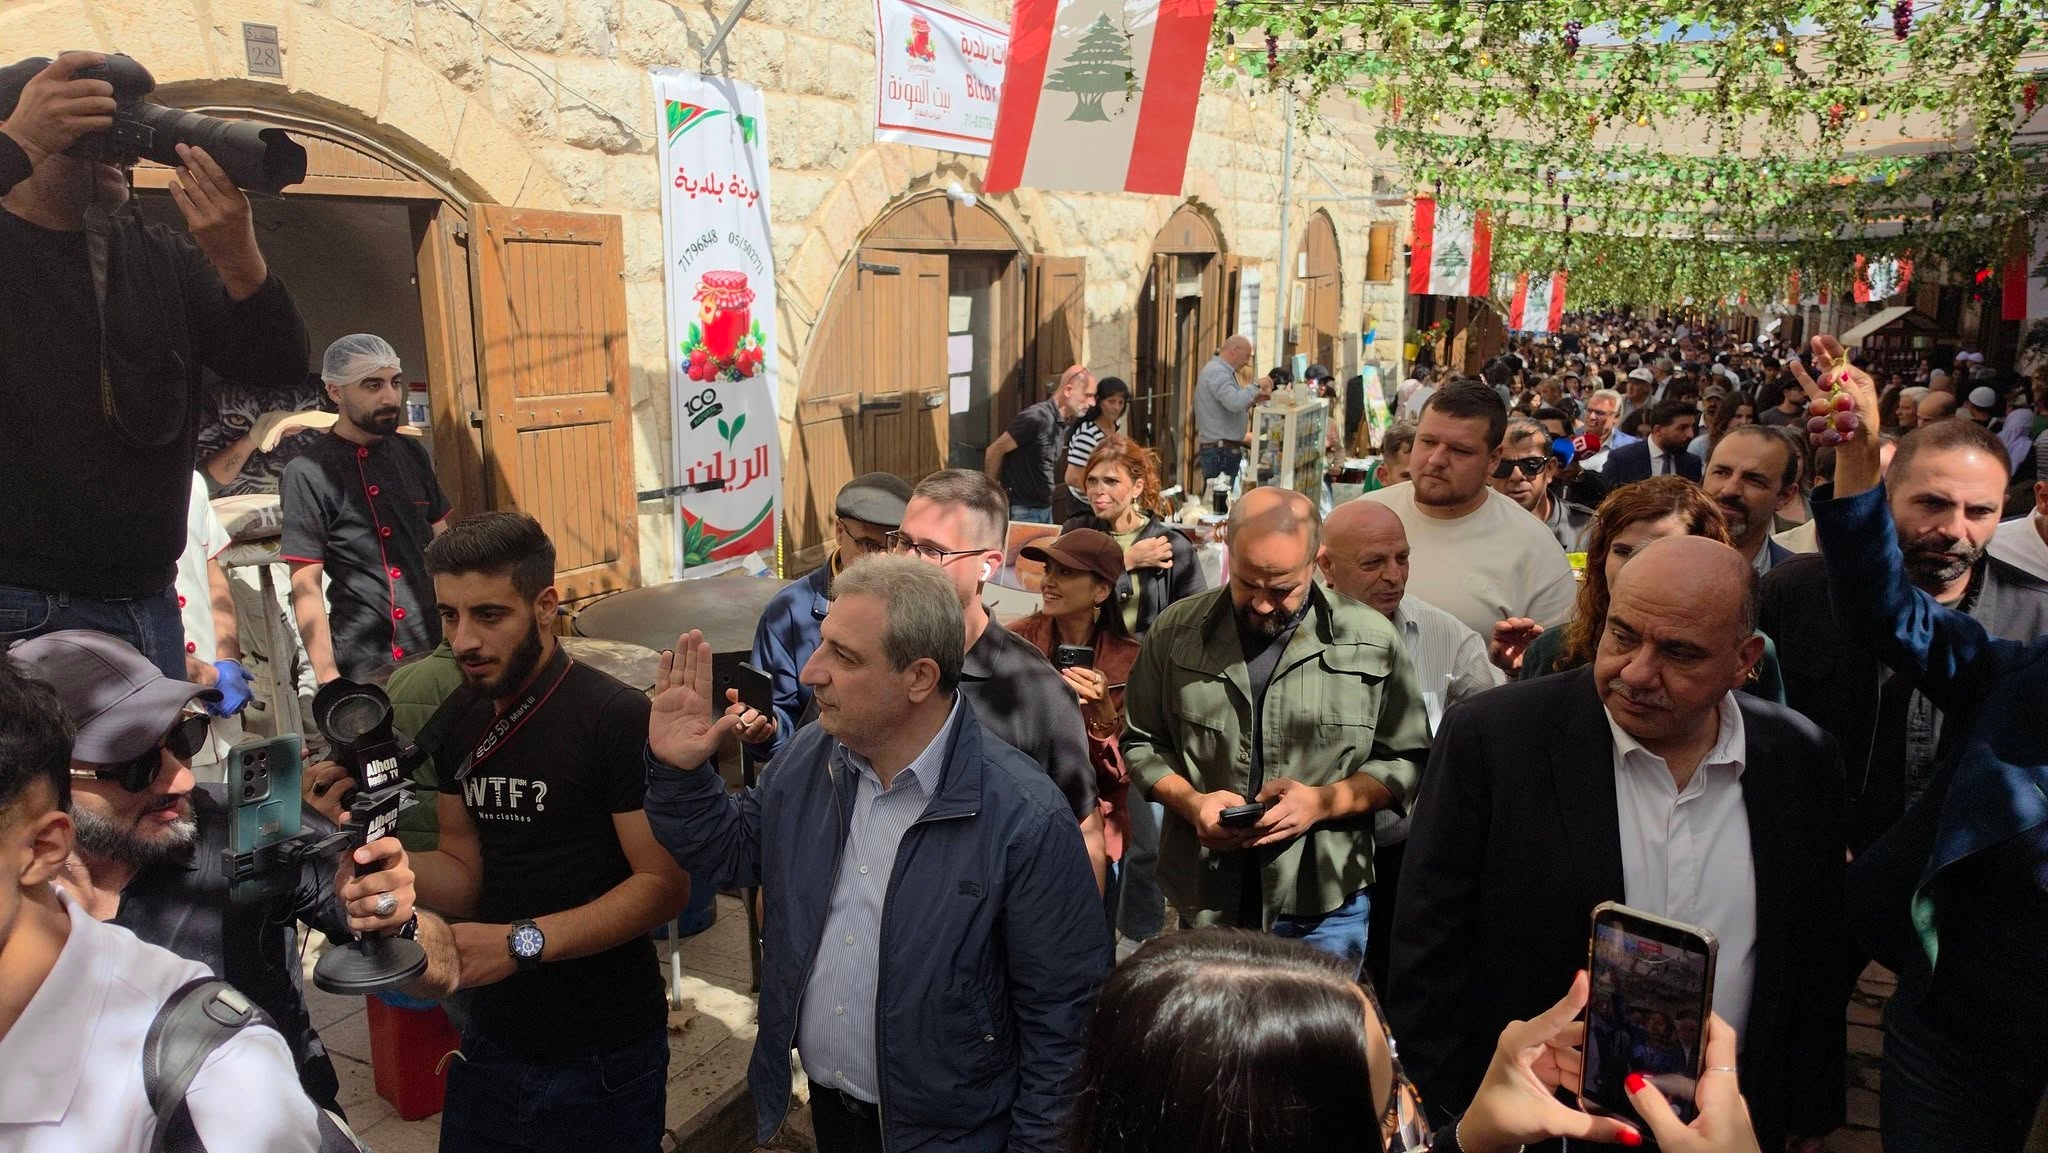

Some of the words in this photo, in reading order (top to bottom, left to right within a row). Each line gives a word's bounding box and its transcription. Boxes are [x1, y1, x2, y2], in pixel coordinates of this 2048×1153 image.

[252, 47, 276, 67] 28
[889, 75, 929, 110] المونة
[933, 86, 951, 115] بيت
[674, 167, 724, 203] بلدية
[678, 229, 719, 273] 71796848
[476, 732, 498, 758] EOS
[495, 719, 510, 736] 5D
[509, 701, 531, 722] Mark
[366, 757, 398, 777] Alhan
[389, 768, 399, 779] TV
[366, 808, 398, 834] Alhan
[387, 818, 398, 832] TV
[496, 812, 531, 823] clothes
